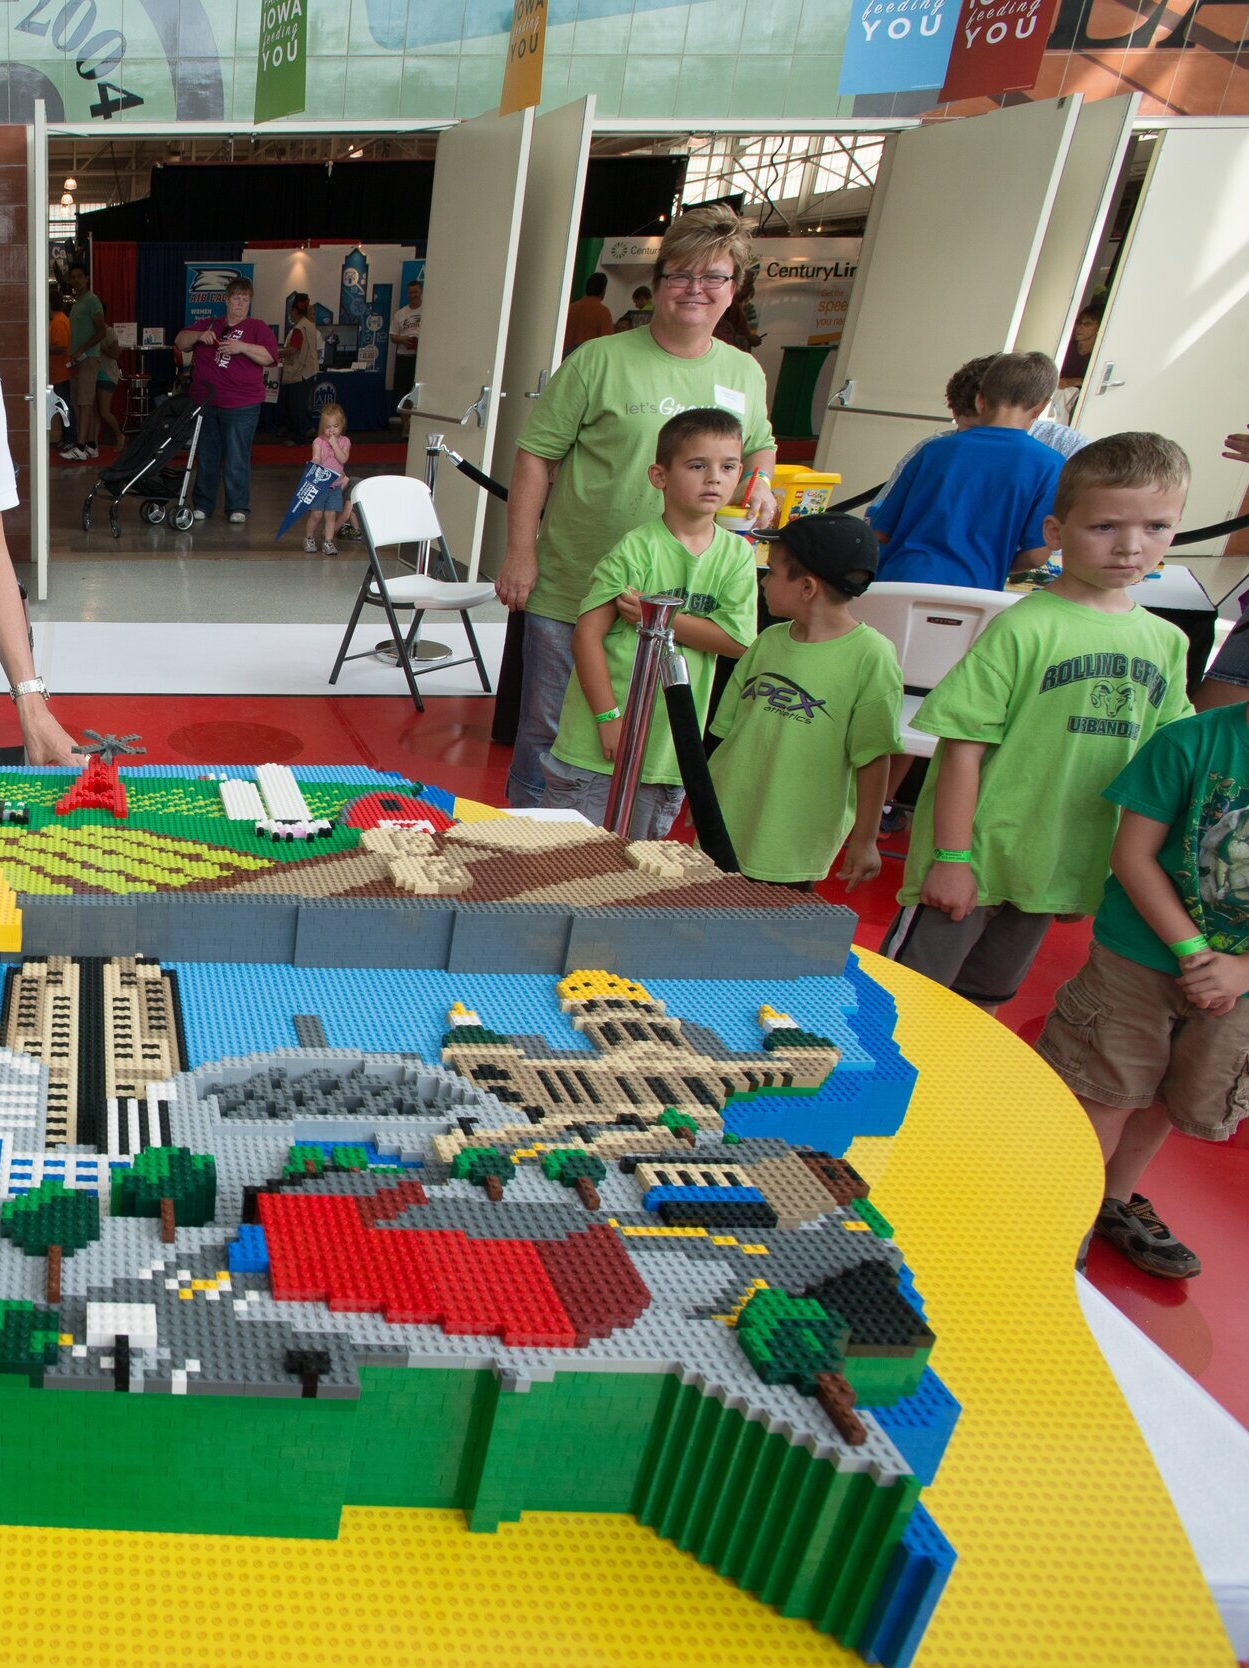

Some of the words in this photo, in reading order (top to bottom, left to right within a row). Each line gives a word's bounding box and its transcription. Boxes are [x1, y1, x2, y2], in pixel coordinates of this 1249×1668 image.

[263, 0, 302, 32] IOWA
[862, 0, 945, 21] feeding
[965, 0, 1042, 28] feeding
[262, 23, 298, 52] feeding
[862, 14, 942, 41] YOU
[965, 16, 1037, 49] YOU
[262, 39, 298, 71] YOU
[511, 32, 539, 63] YOU
[630, 245, 661, 255] Centur
[625, 402, 658, 414] let's
[1038, 652, 1129, 695] ROLLING
[741, 681, 826, 718] APEX
[763, 705, 812, 724] athletics
